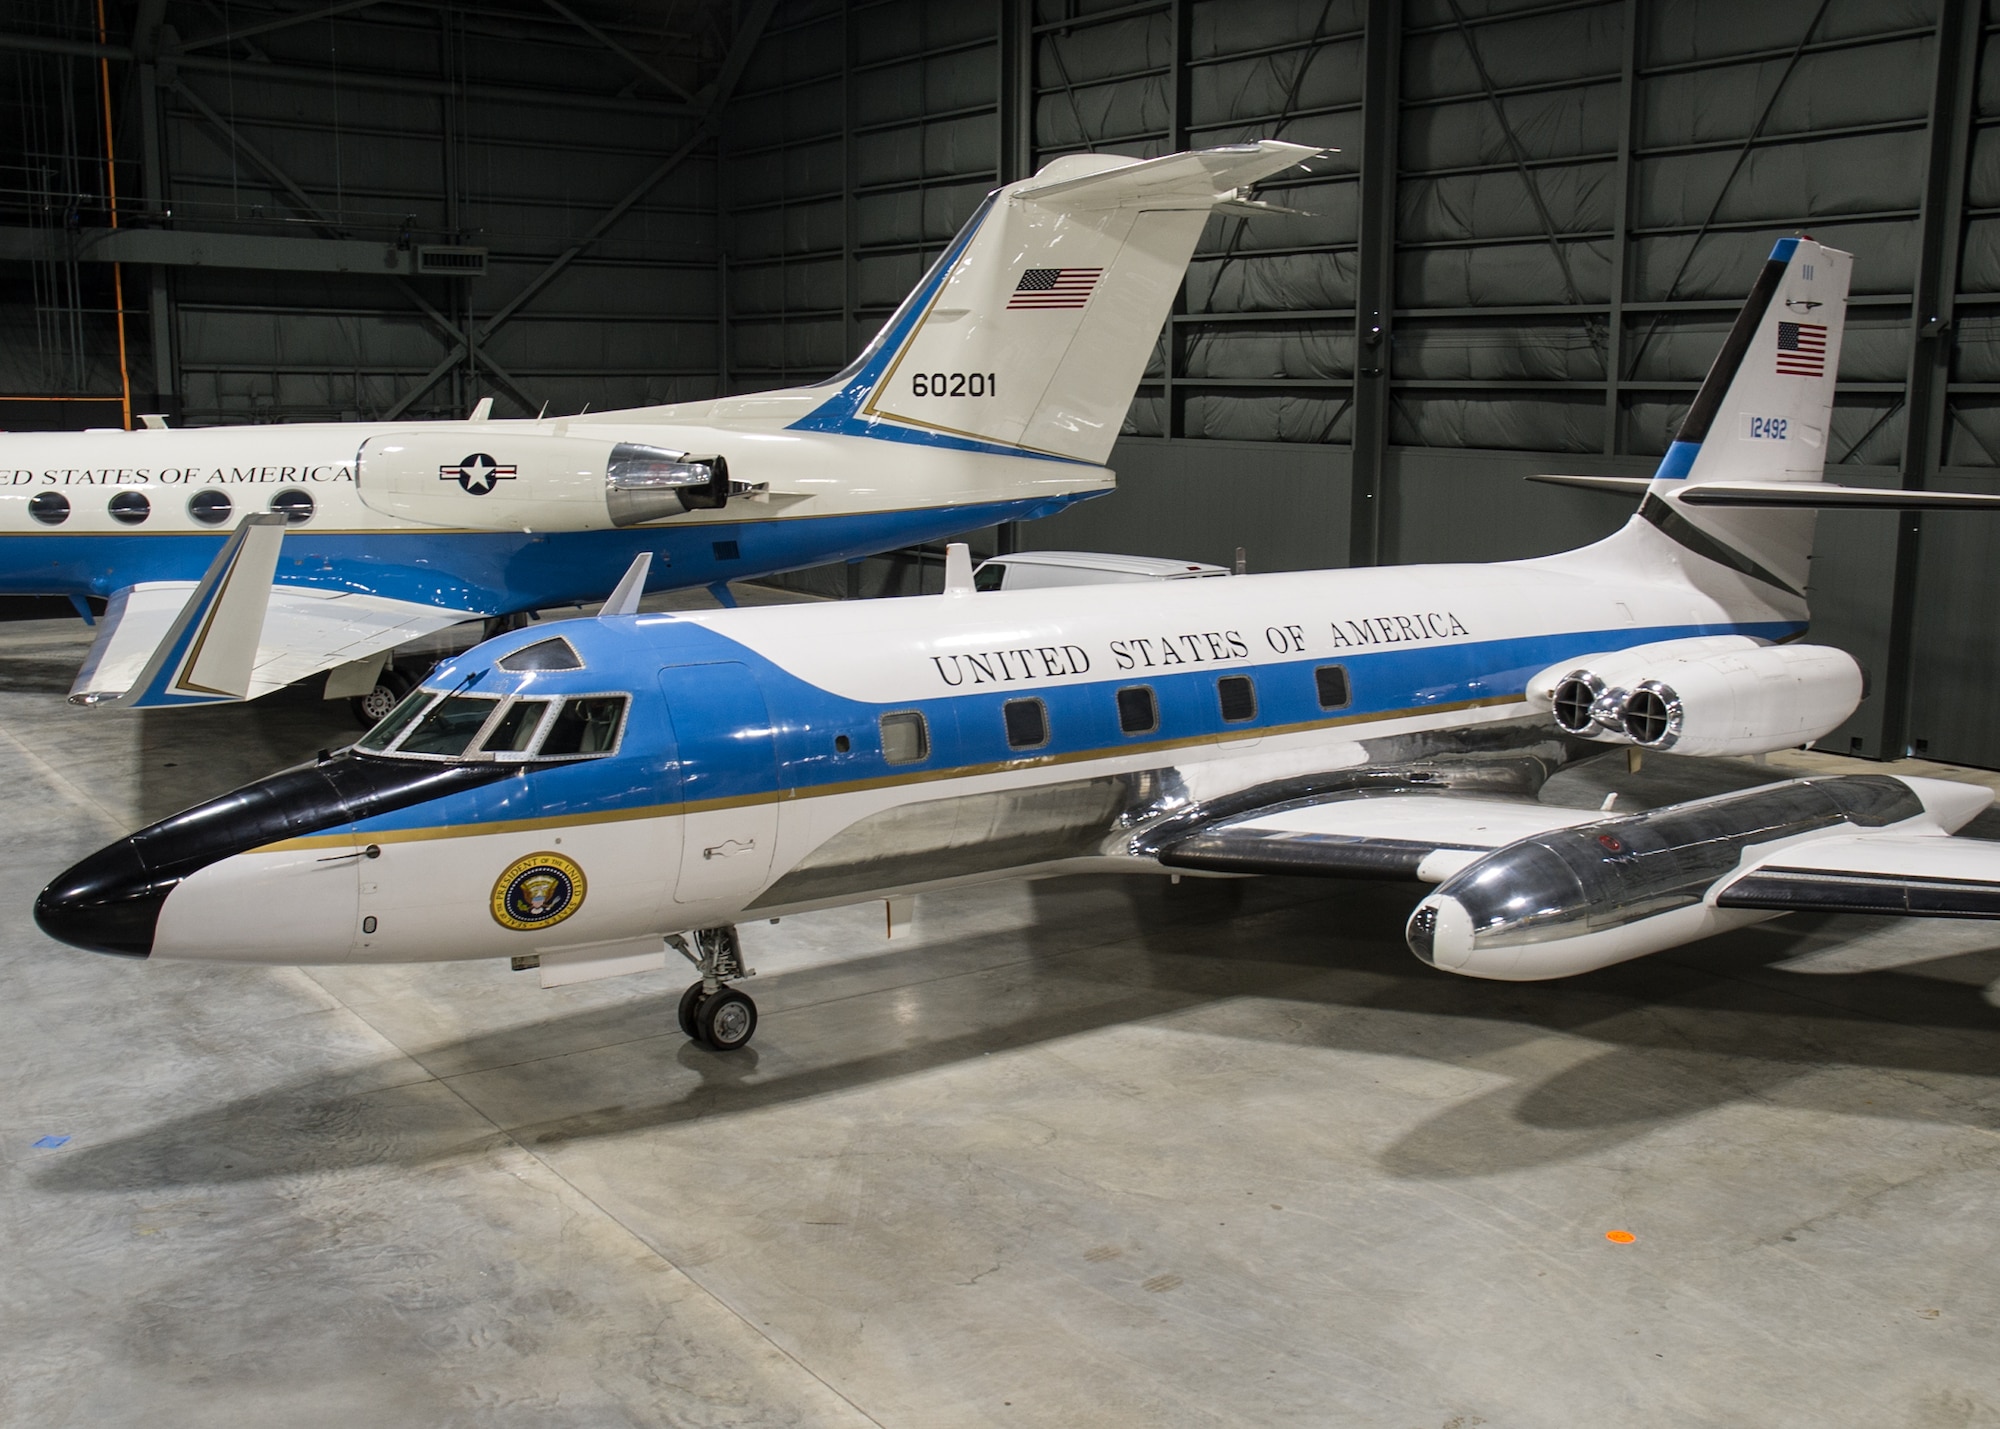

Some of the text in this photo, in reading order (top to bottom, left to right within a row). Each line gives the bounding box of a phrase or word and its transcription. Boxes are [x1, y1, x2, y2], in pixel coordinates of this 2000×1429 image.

[912, 373, 996, 397] 60201
[1750, 416, 1788, 439] 12492
[41, 469, 150, 485] STATES
[160, 467, 200, 484] OF
[206, 466, 353, 484] AMERICA
[930, 612, 1469, 686] UNITED STATES OF AMERICA
[496, 858, 538, 900] PRESIDENT
[564, 864, 582, 897] UNITED
